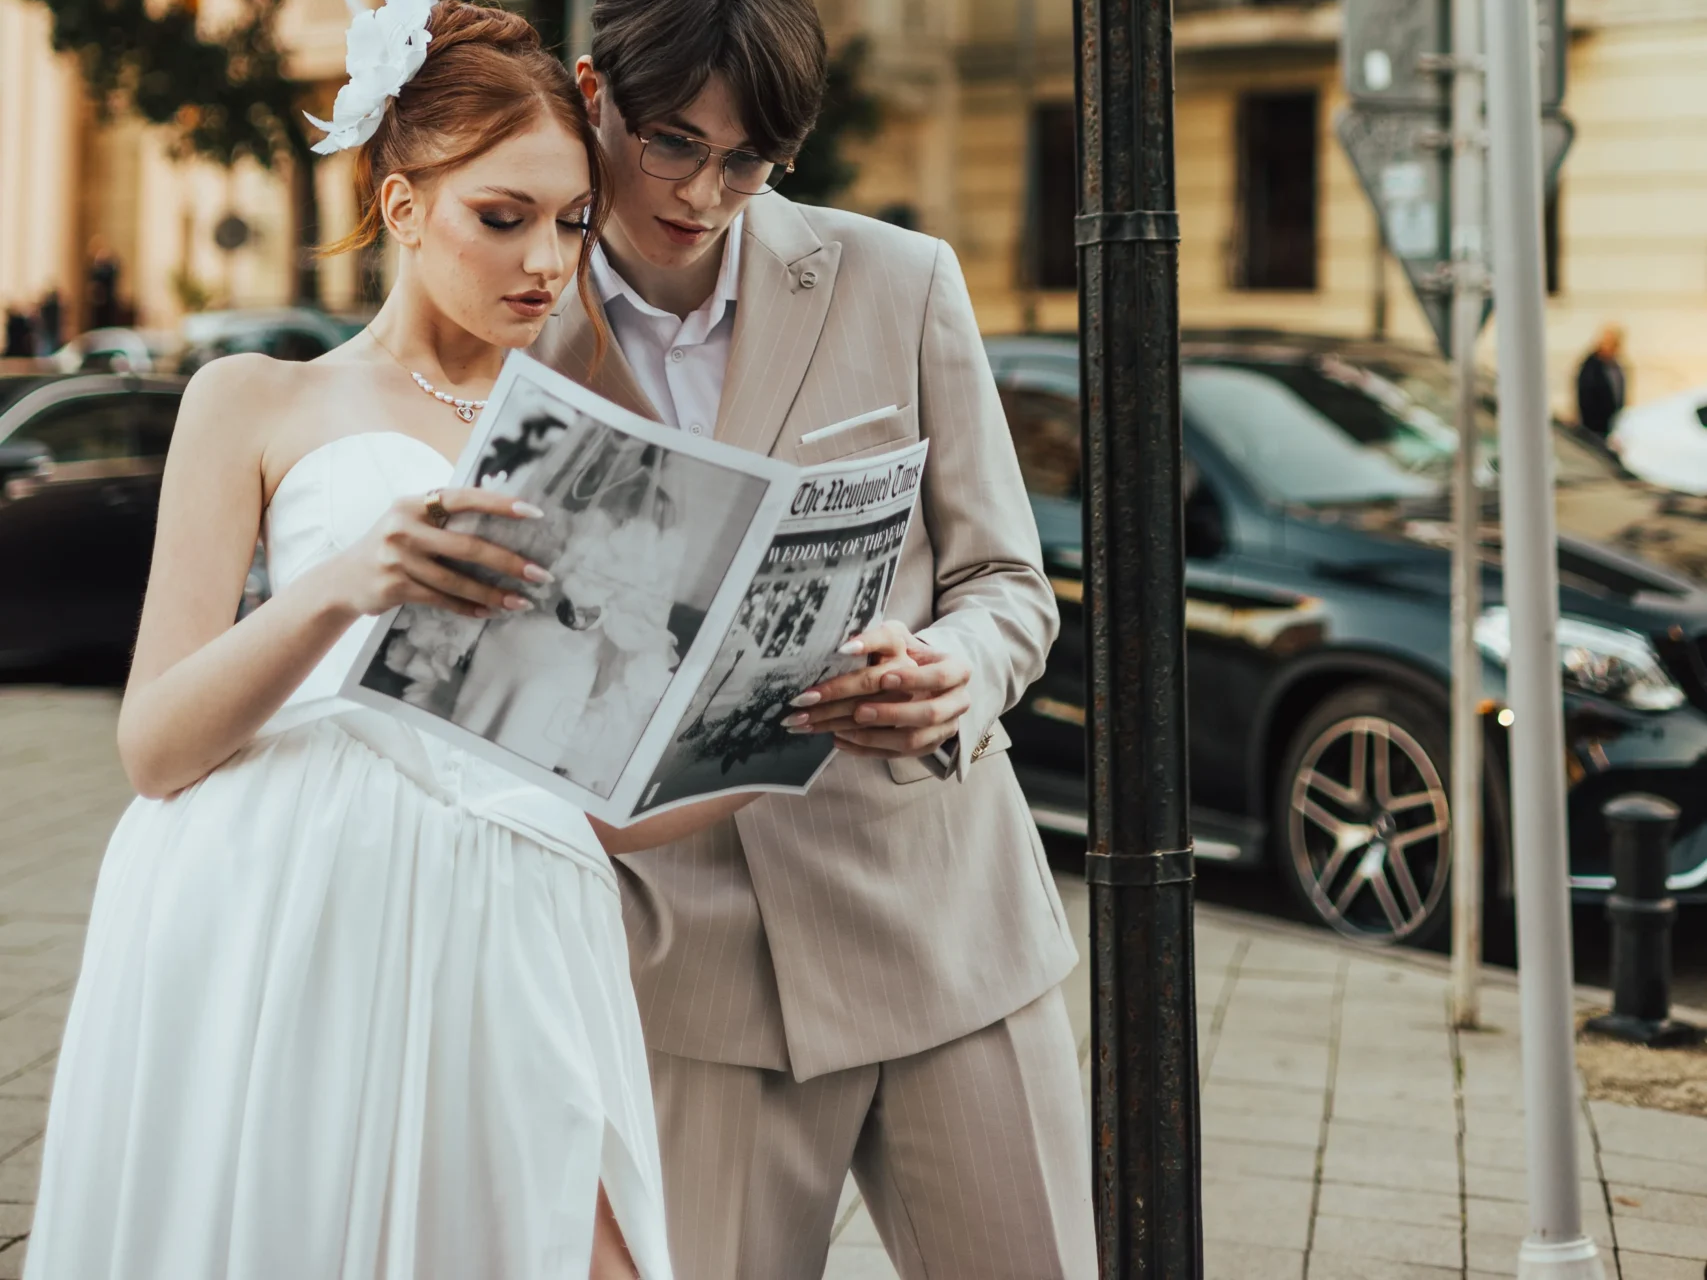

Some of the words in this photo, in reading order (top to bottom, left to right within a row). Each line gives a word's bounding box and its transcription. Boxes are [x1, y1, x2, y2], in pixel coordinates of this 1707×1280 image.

[790, 479, 824, 517] The
[822, 467, 892, 515] Newlywed
[891, 460, 921, 498] Times
[768, 540, 841, 564] WEDDING
[842, 538, 861, 556] OF
[862, 530, 887, 552] THE
[882, 520, 906, 546] YEAR
